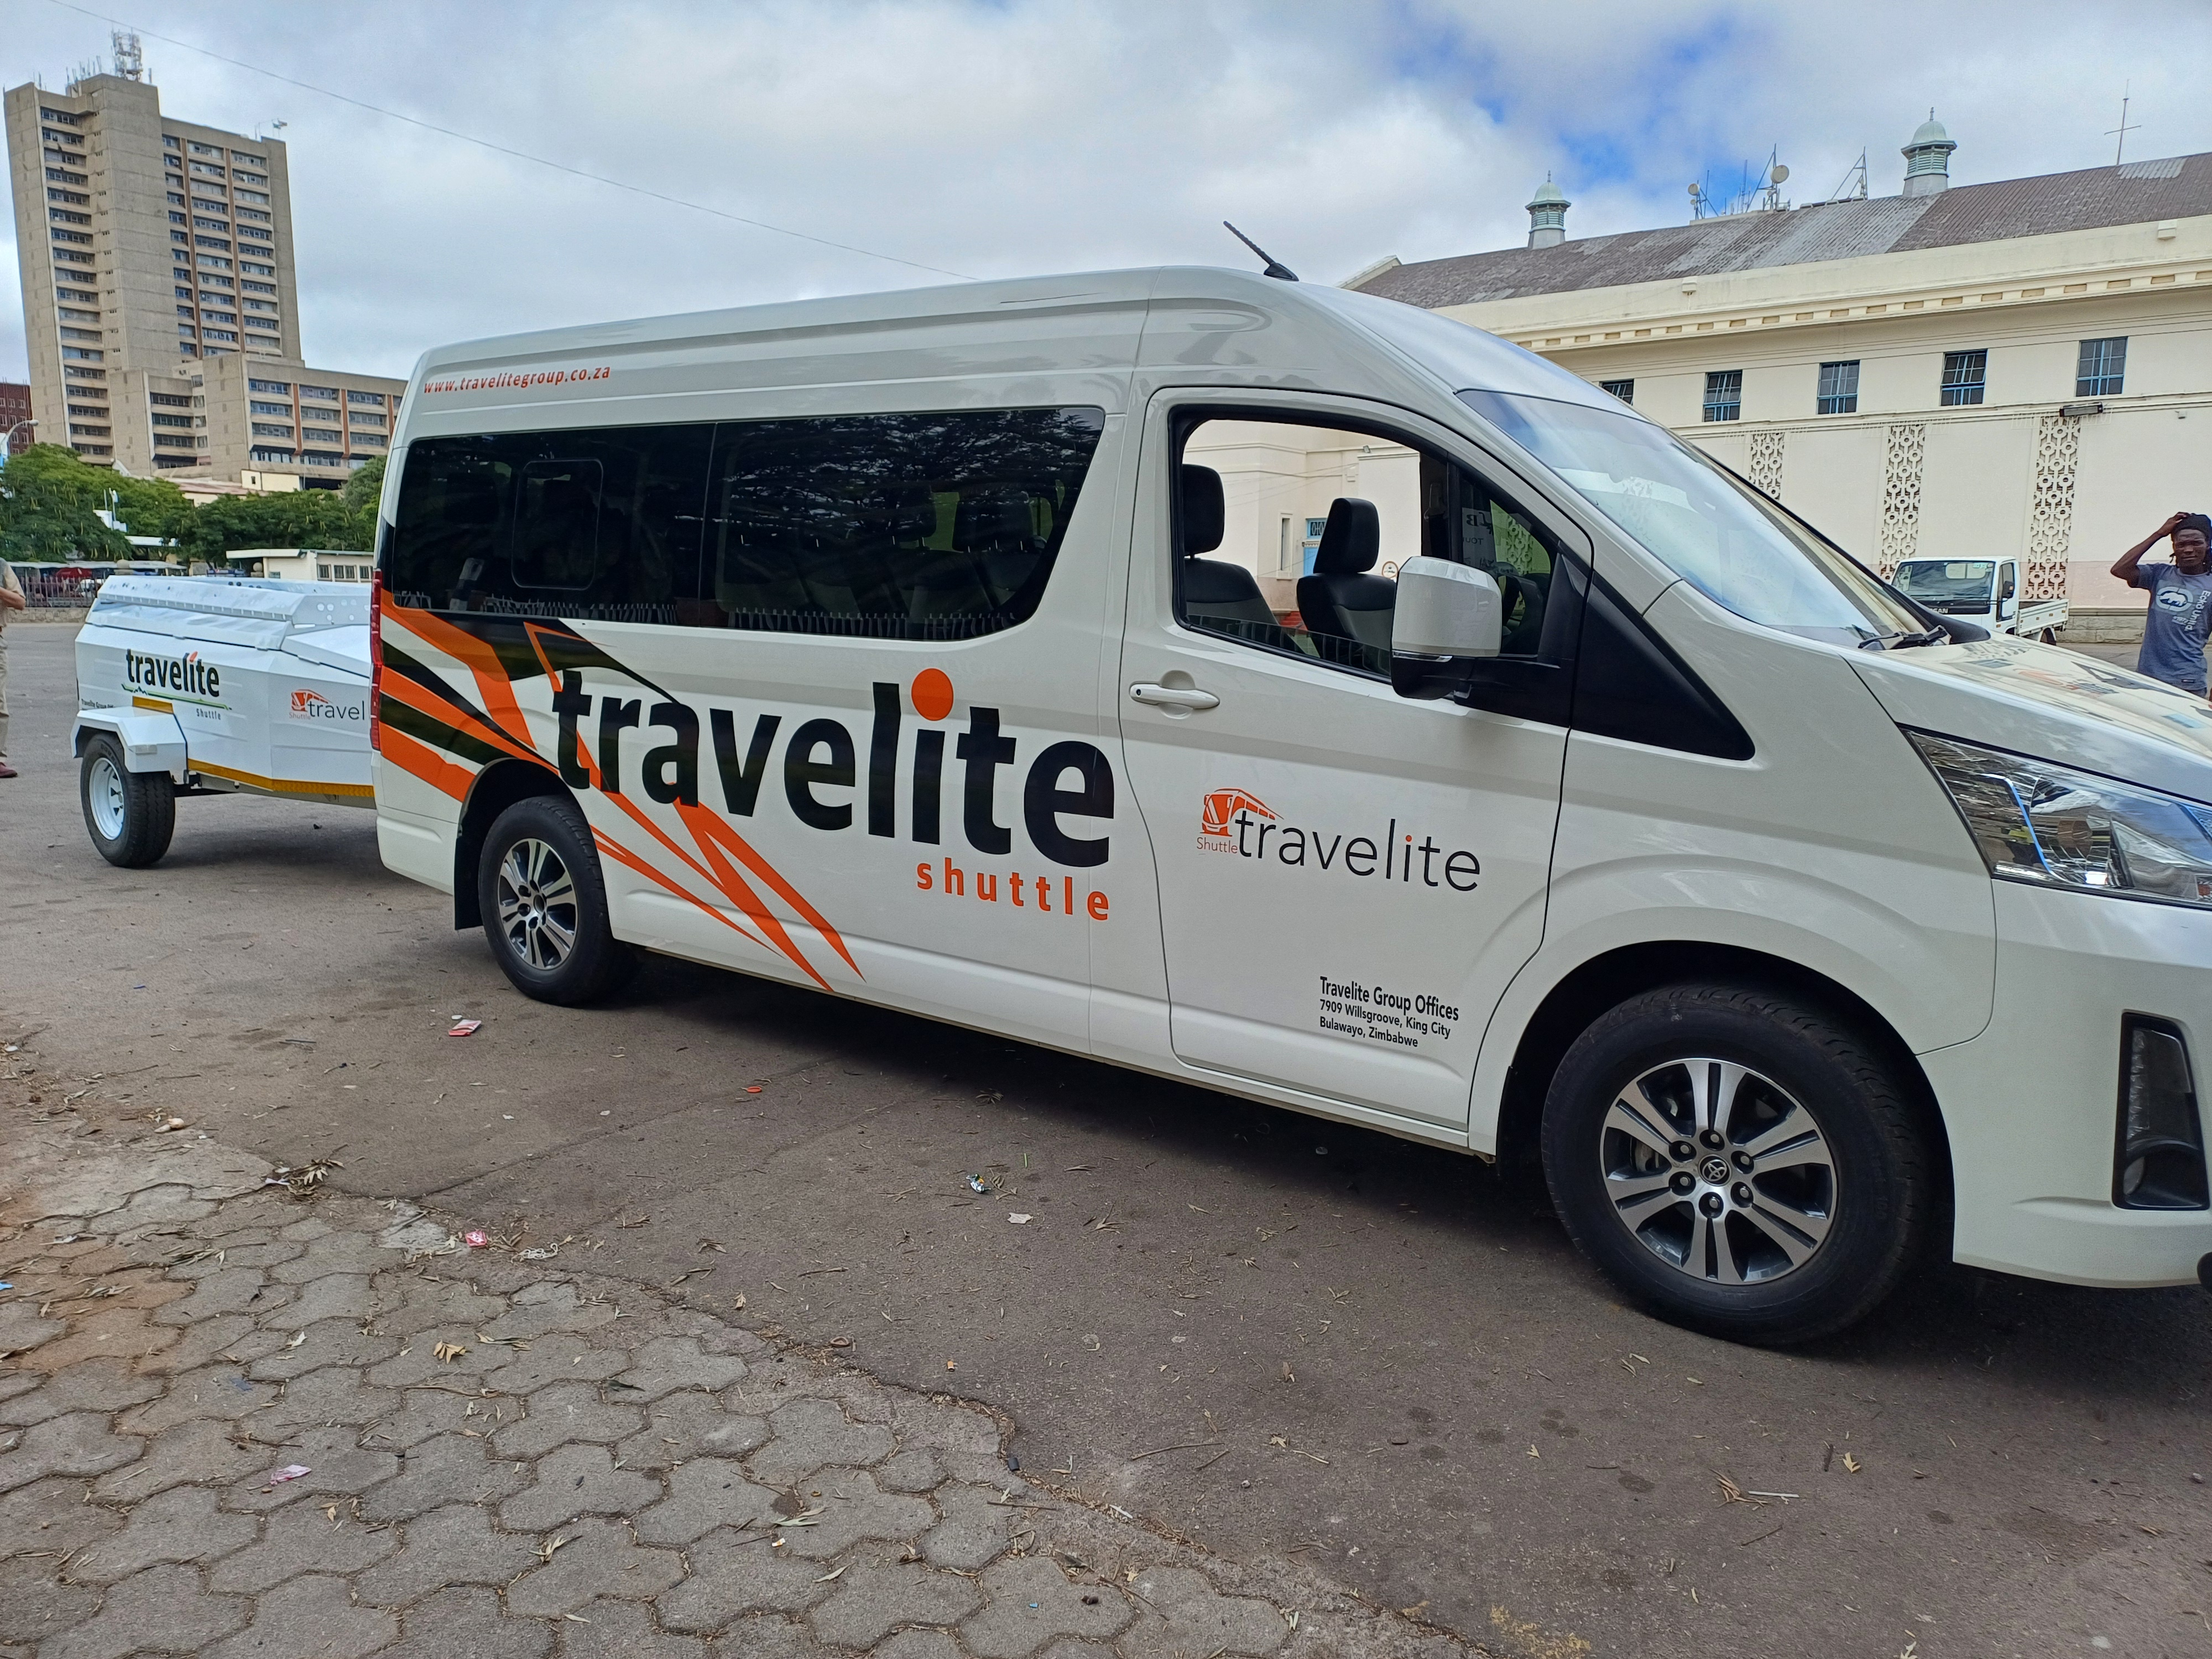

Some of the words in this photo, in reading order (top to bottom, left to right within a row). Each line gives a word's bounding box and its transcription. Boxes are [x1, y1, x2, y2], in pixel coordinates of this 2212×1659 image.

[424, 366, 611, 394] www.travelitegroup.co.za
[126, 649, 220, 697] travelite
[307, 700, 365, 721] travel
[552, 667, 1114, 868] travelite
[1196, 837, 1238, 854] Shuttle
[1234, 810, 1480, 891] travelite
[916, 857, 1109, 921] shuttle
[1319, 999, 1343, 1014] 7909
[1345, 1003, 1403, 1028] Willsgroove,
[1406, 1016, 1428, 1035] King
[1431, 1021, 1451, 1040] City
[1320, 975, 1370, 1003] Travelite
[1374, 987, 1411, 1015] Group
[1415, 994, 1459, 1021] Offices
[1319, 1016, 1366, 1039] Bulawayo,
[1369, 1026, 1418, 1047] Zimbabwe
